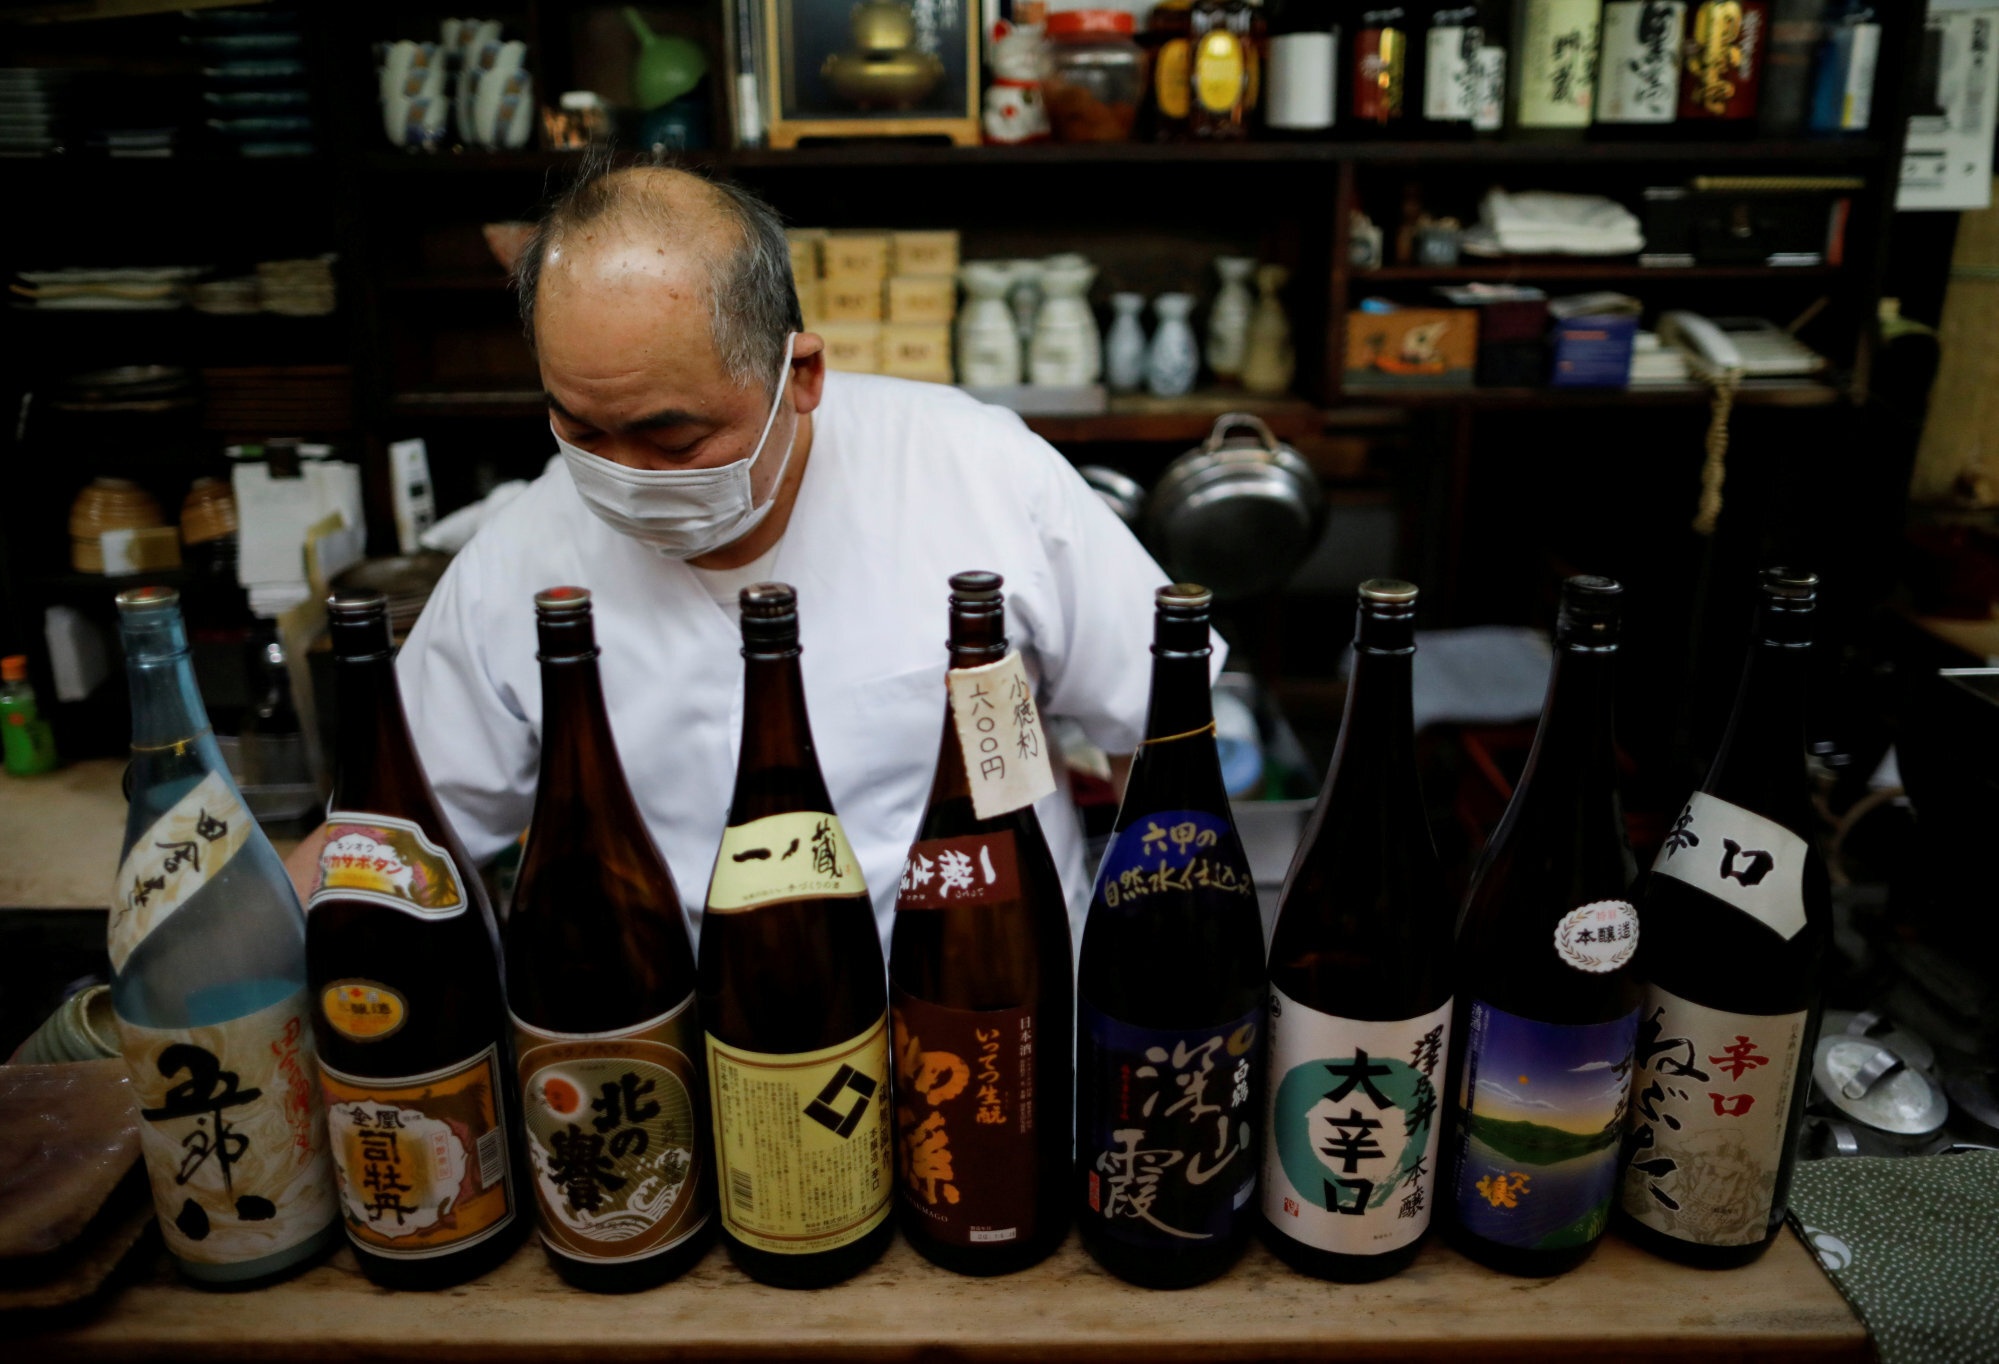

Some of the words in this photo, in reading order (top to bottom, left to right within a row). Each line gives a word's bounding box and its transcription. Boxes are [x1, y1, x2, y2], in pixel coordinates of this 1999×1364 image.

[1008, 673, 1039, 761] 小徳利
[336, 841, 375, 853] キンオウ
[1141, 822, 1217, 856] 六甲の
[1104, 856, 1251, 908] 自然水仕込み
[1574, 926, 1632, 957] 本醸造
[1019, 1015, 1033, 1056] 日本酒
[1232, 1058, 1250, 1108] 白鶴
[1404, 1024, 1444, 1137] 澤乃井
[1708, 1035, 1770, 1117] 辛口
[1320, 1047, 1395, 1215] 大辛口
[358, 1130, 418, 1226] 司牡丹
